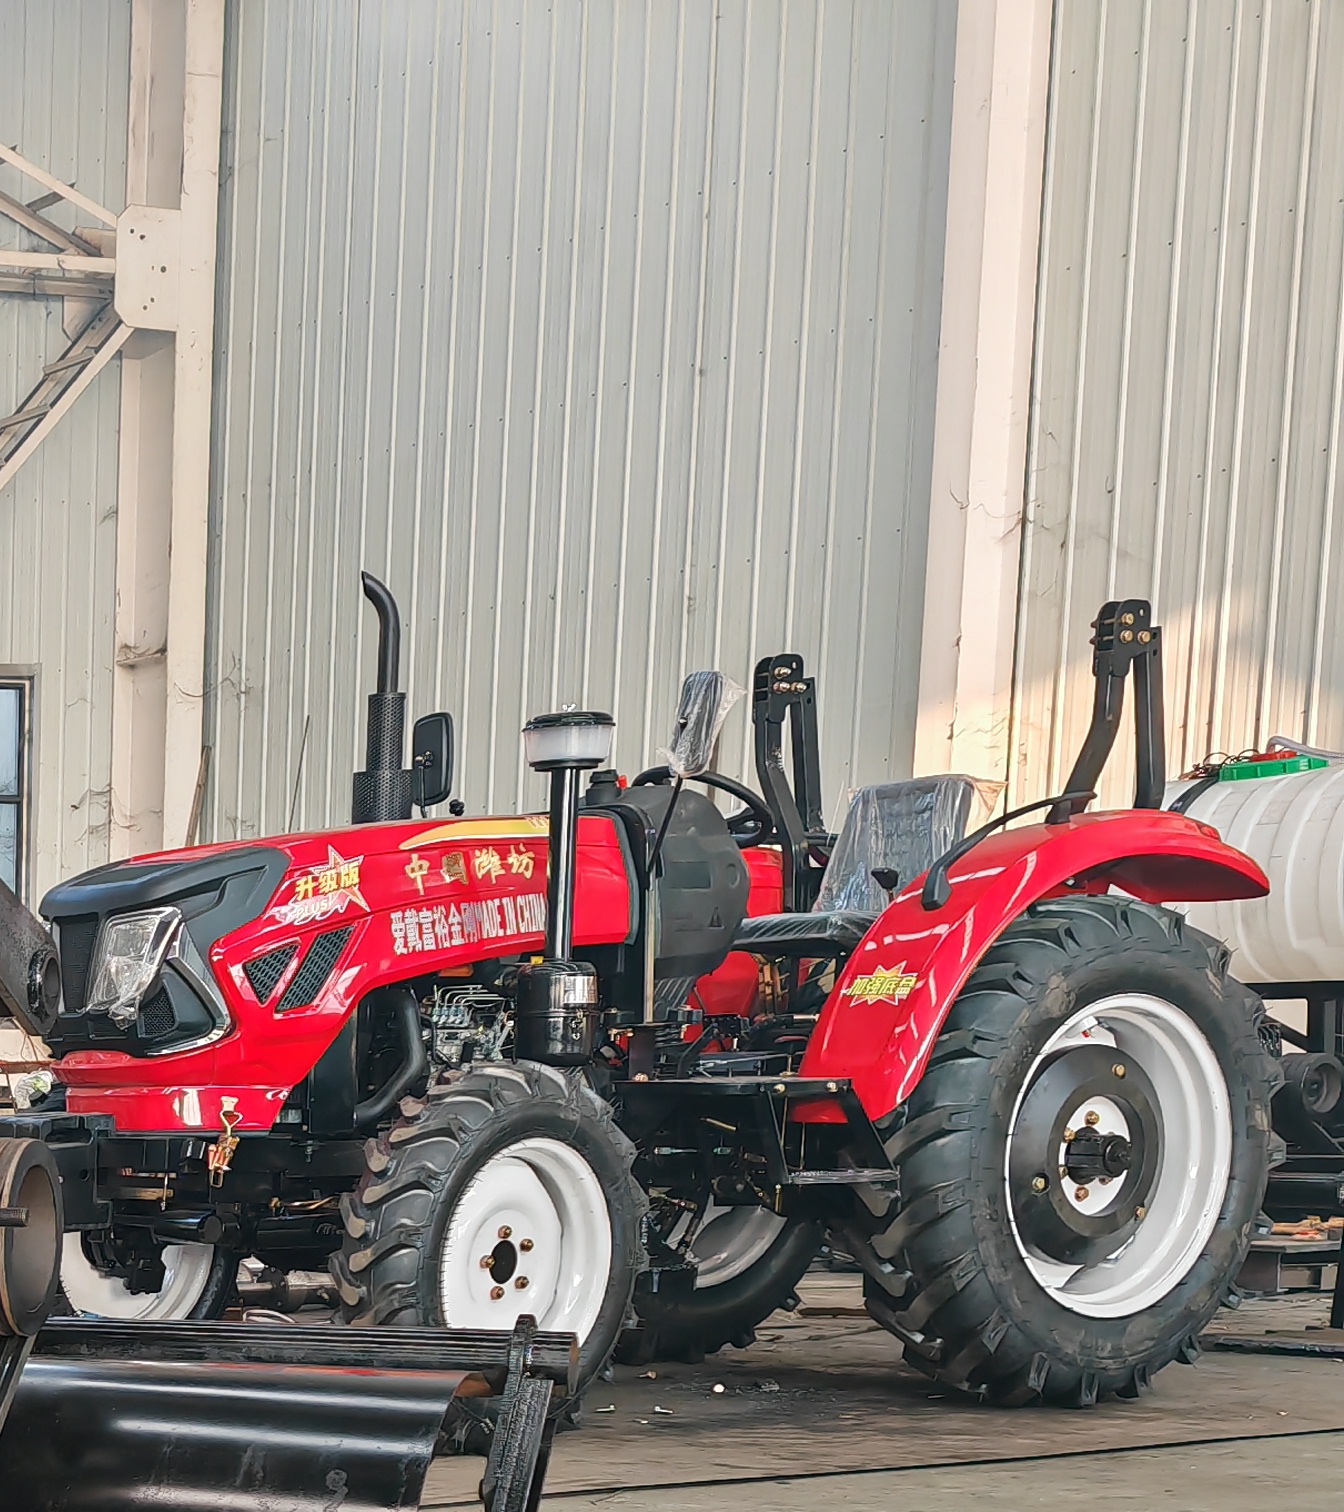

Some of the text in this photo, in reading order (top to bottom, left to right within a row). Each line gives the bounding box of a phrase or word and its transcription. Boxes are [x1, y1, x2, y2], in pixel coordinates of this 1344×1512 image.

[295, 861, 360, 901] 升级版
[296, 898, 329, 918] PLUS
[502, 896, 517, 936] IN
